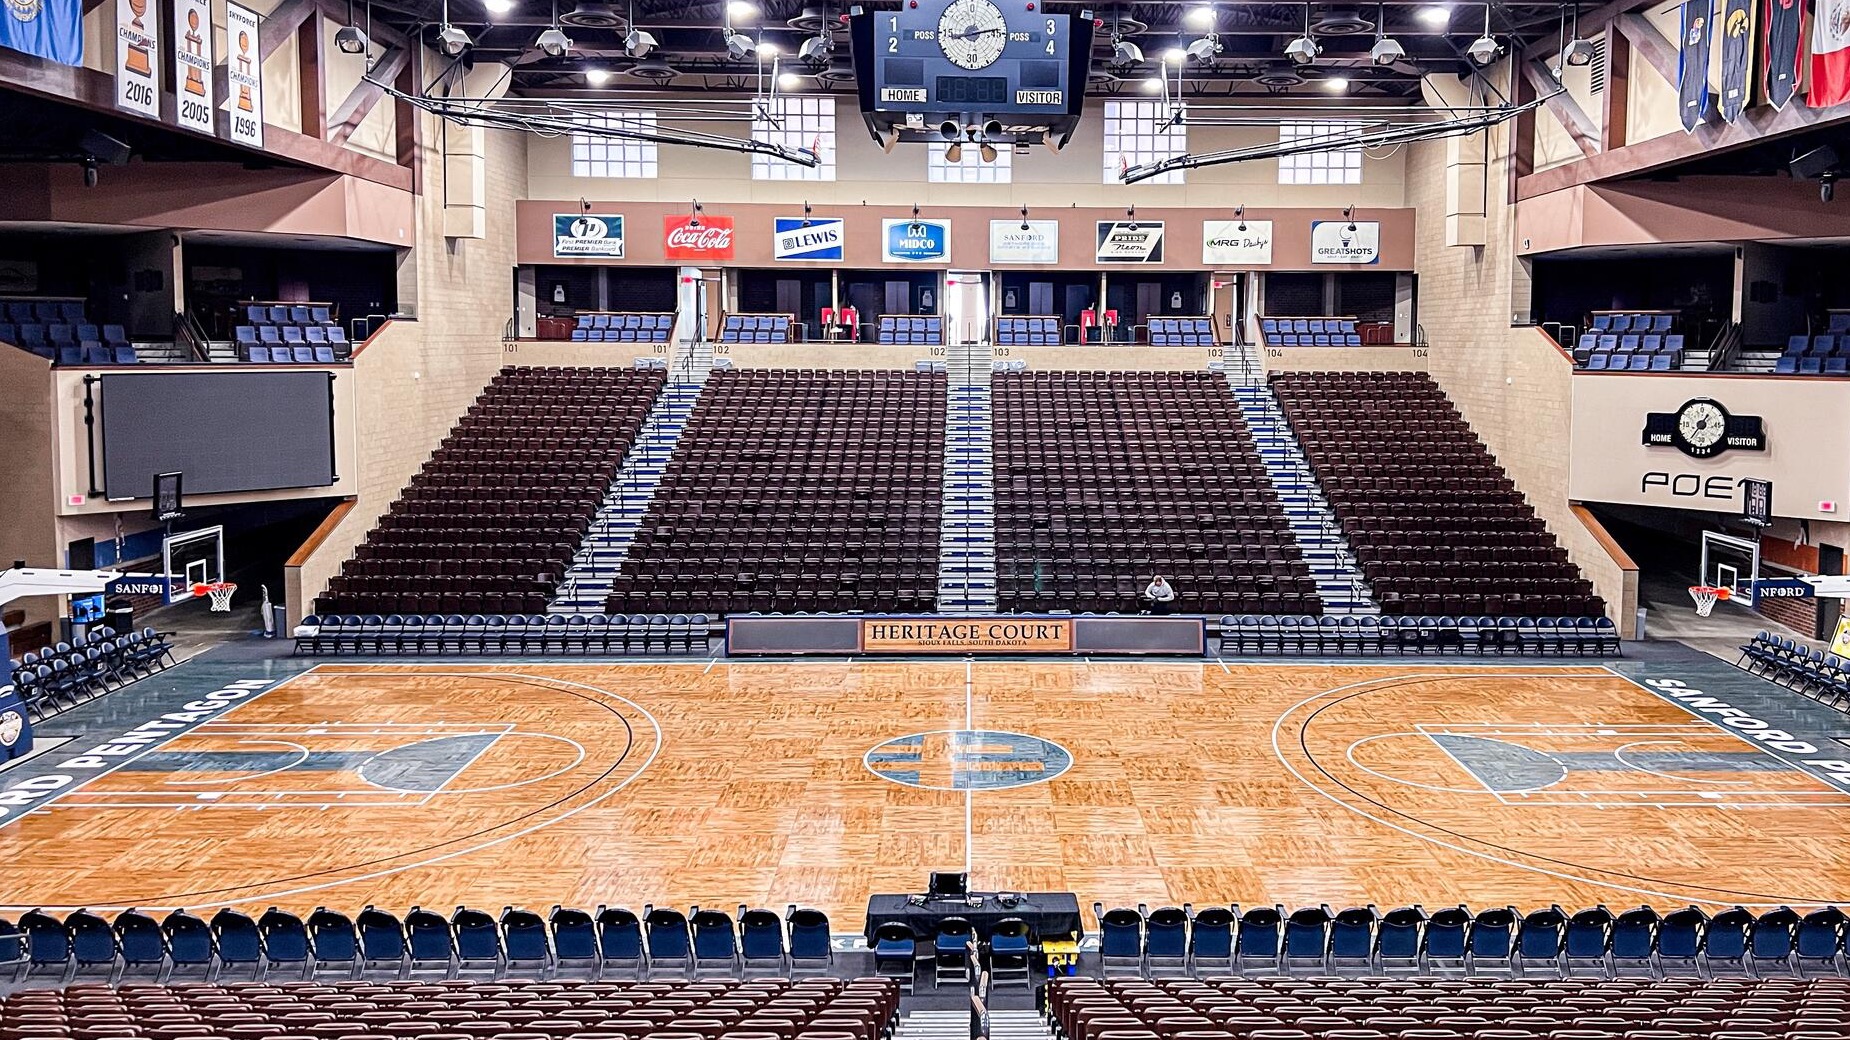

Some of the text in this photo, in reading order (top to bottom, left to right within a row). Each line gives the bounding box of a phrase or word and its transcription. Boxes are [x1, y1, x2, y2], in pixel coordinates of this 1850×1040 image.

[889, 16, 898, 32] 1
[1046, 19, 1056, 35] 3
[119, 27, 156, 49] CHAMPINS
[914, 30, 935, 40] POSS
[1009, 32, 1030, 42] POSS
[888, 37, 898, 53] 2
[1045, 39, 1056, 56] 4
[177, 50, 210, 71] CHAMPIONS
[966, 53, 978, 63] 30
[125, 81, 153, 106] 2016
[887, 89, 920, 101] HOME
[1018, 91, 1061, 104] VISITOR
[181, 100, 209, 124] 2005
[234, 116, 257, 138] 1996
[794, 229, 838, 248] LEWIS
[899, 239, 935, 249] MIDCO
[1210, 239, 1240, 247] MRG
[1317, 247, 1373, 255] GREATSHOTS
[504, 343, 518, 353] 101
[653, 345, 667, 354] 101
[713, 345, 730, 354] 102
[929, 347, 946, 356] 102
[994, 348, 1010, 357] 103
[1207, 348, 1223, 357] 103
[1267, 349, 1283, 358] 104
[1412, 349, 1428, 358] 104
[1650, 433, 1672, 443] HOME
[1727, 436, 1758, 447] VISITOR
[871, 624, 1063, 640] HERITAGE COURT
[1645, 678, 1819, 754] SANFORD
[55, 679, 276, 768] PENTAGON
